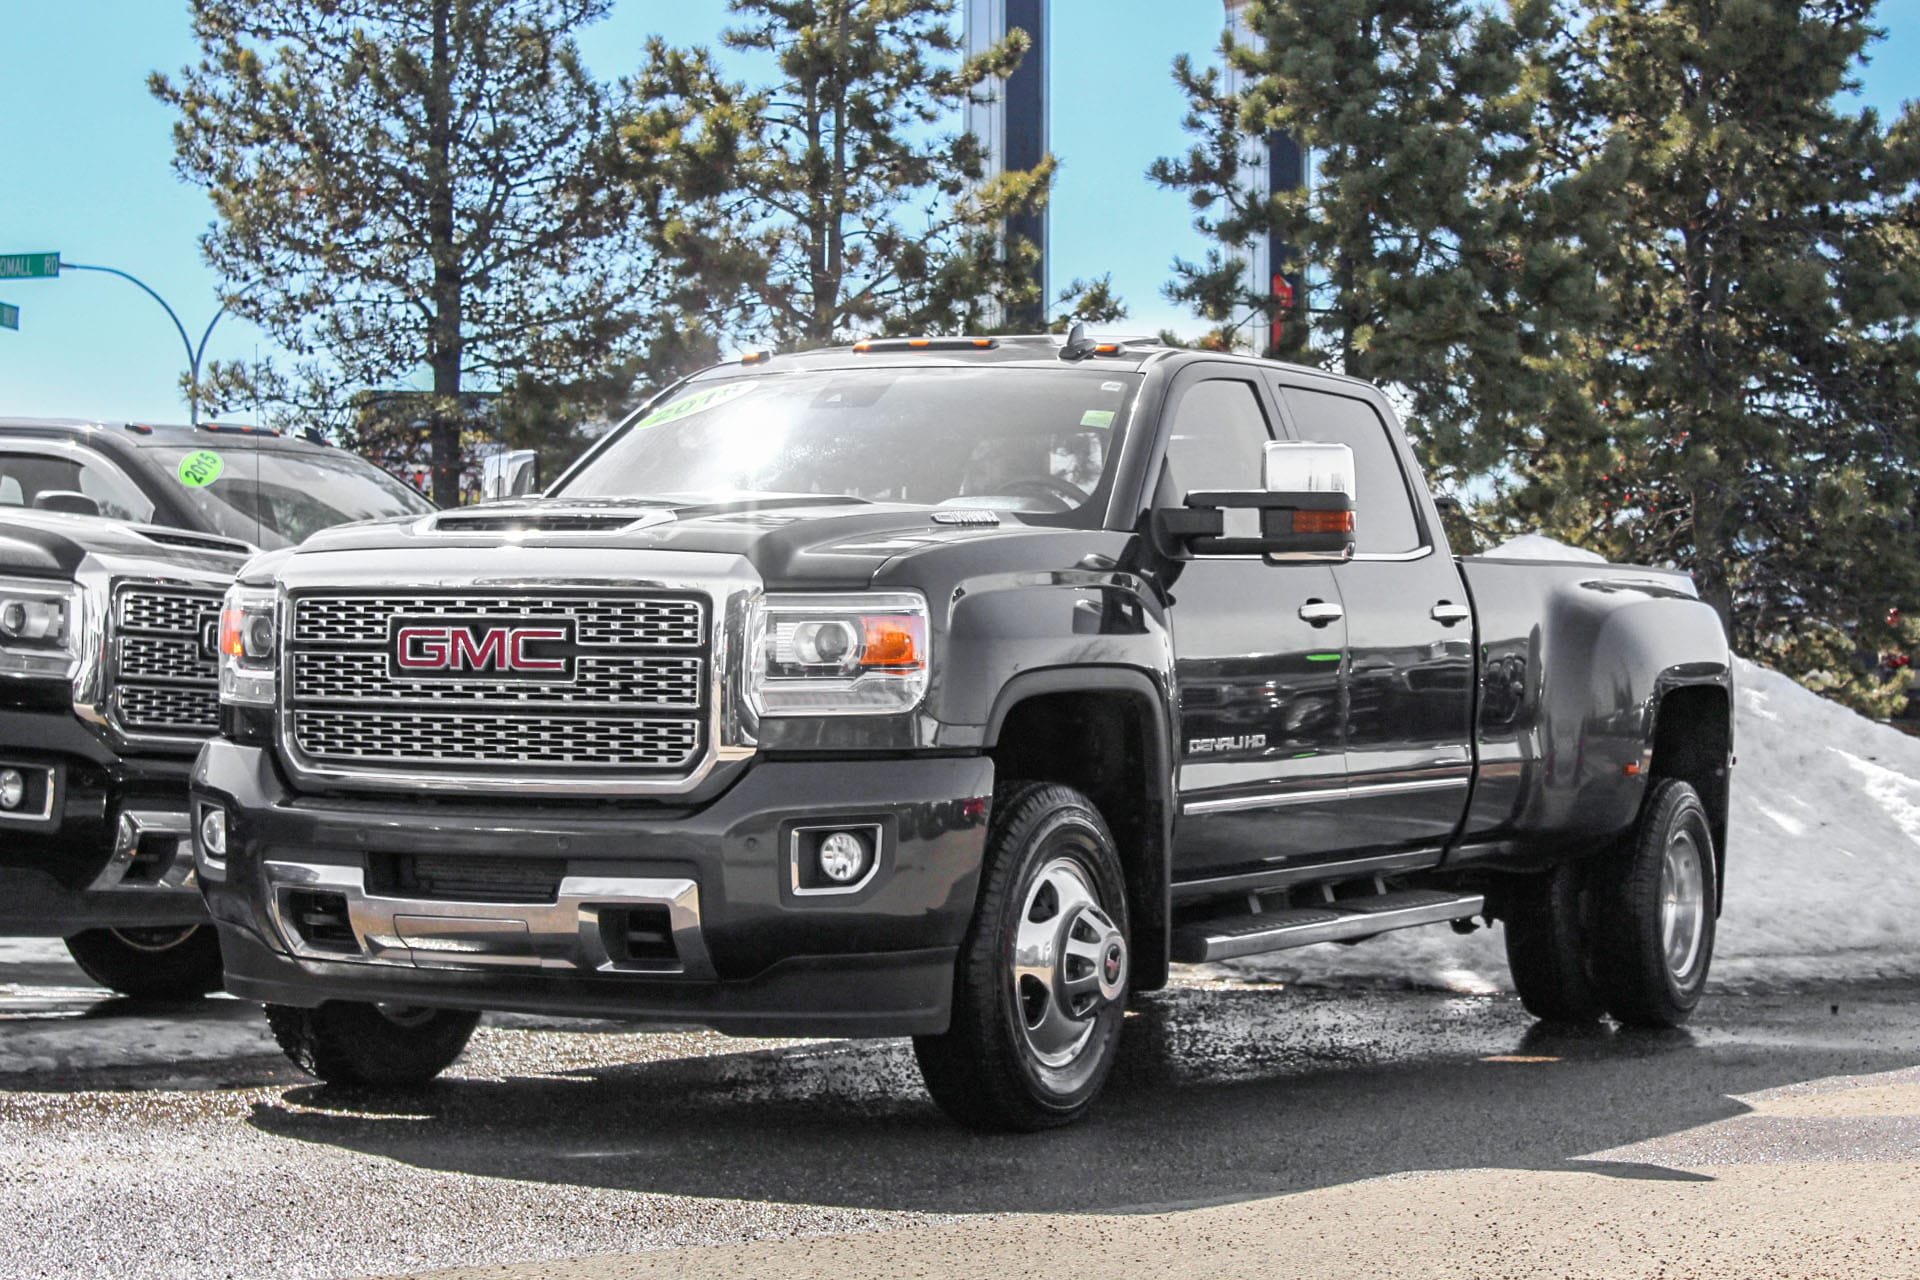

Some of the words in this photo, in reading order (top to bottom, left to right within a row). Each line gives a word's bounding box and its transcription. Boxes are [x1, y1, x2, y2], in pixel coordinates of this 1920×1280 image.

[44, 255, 58, 275] RD
[185, 452, 217, 484] 2015
[397, 626, 567, 672] GMC
[1188, 735, 1243, 754] DENALI
[1244, 734, 1267, 749] HD
